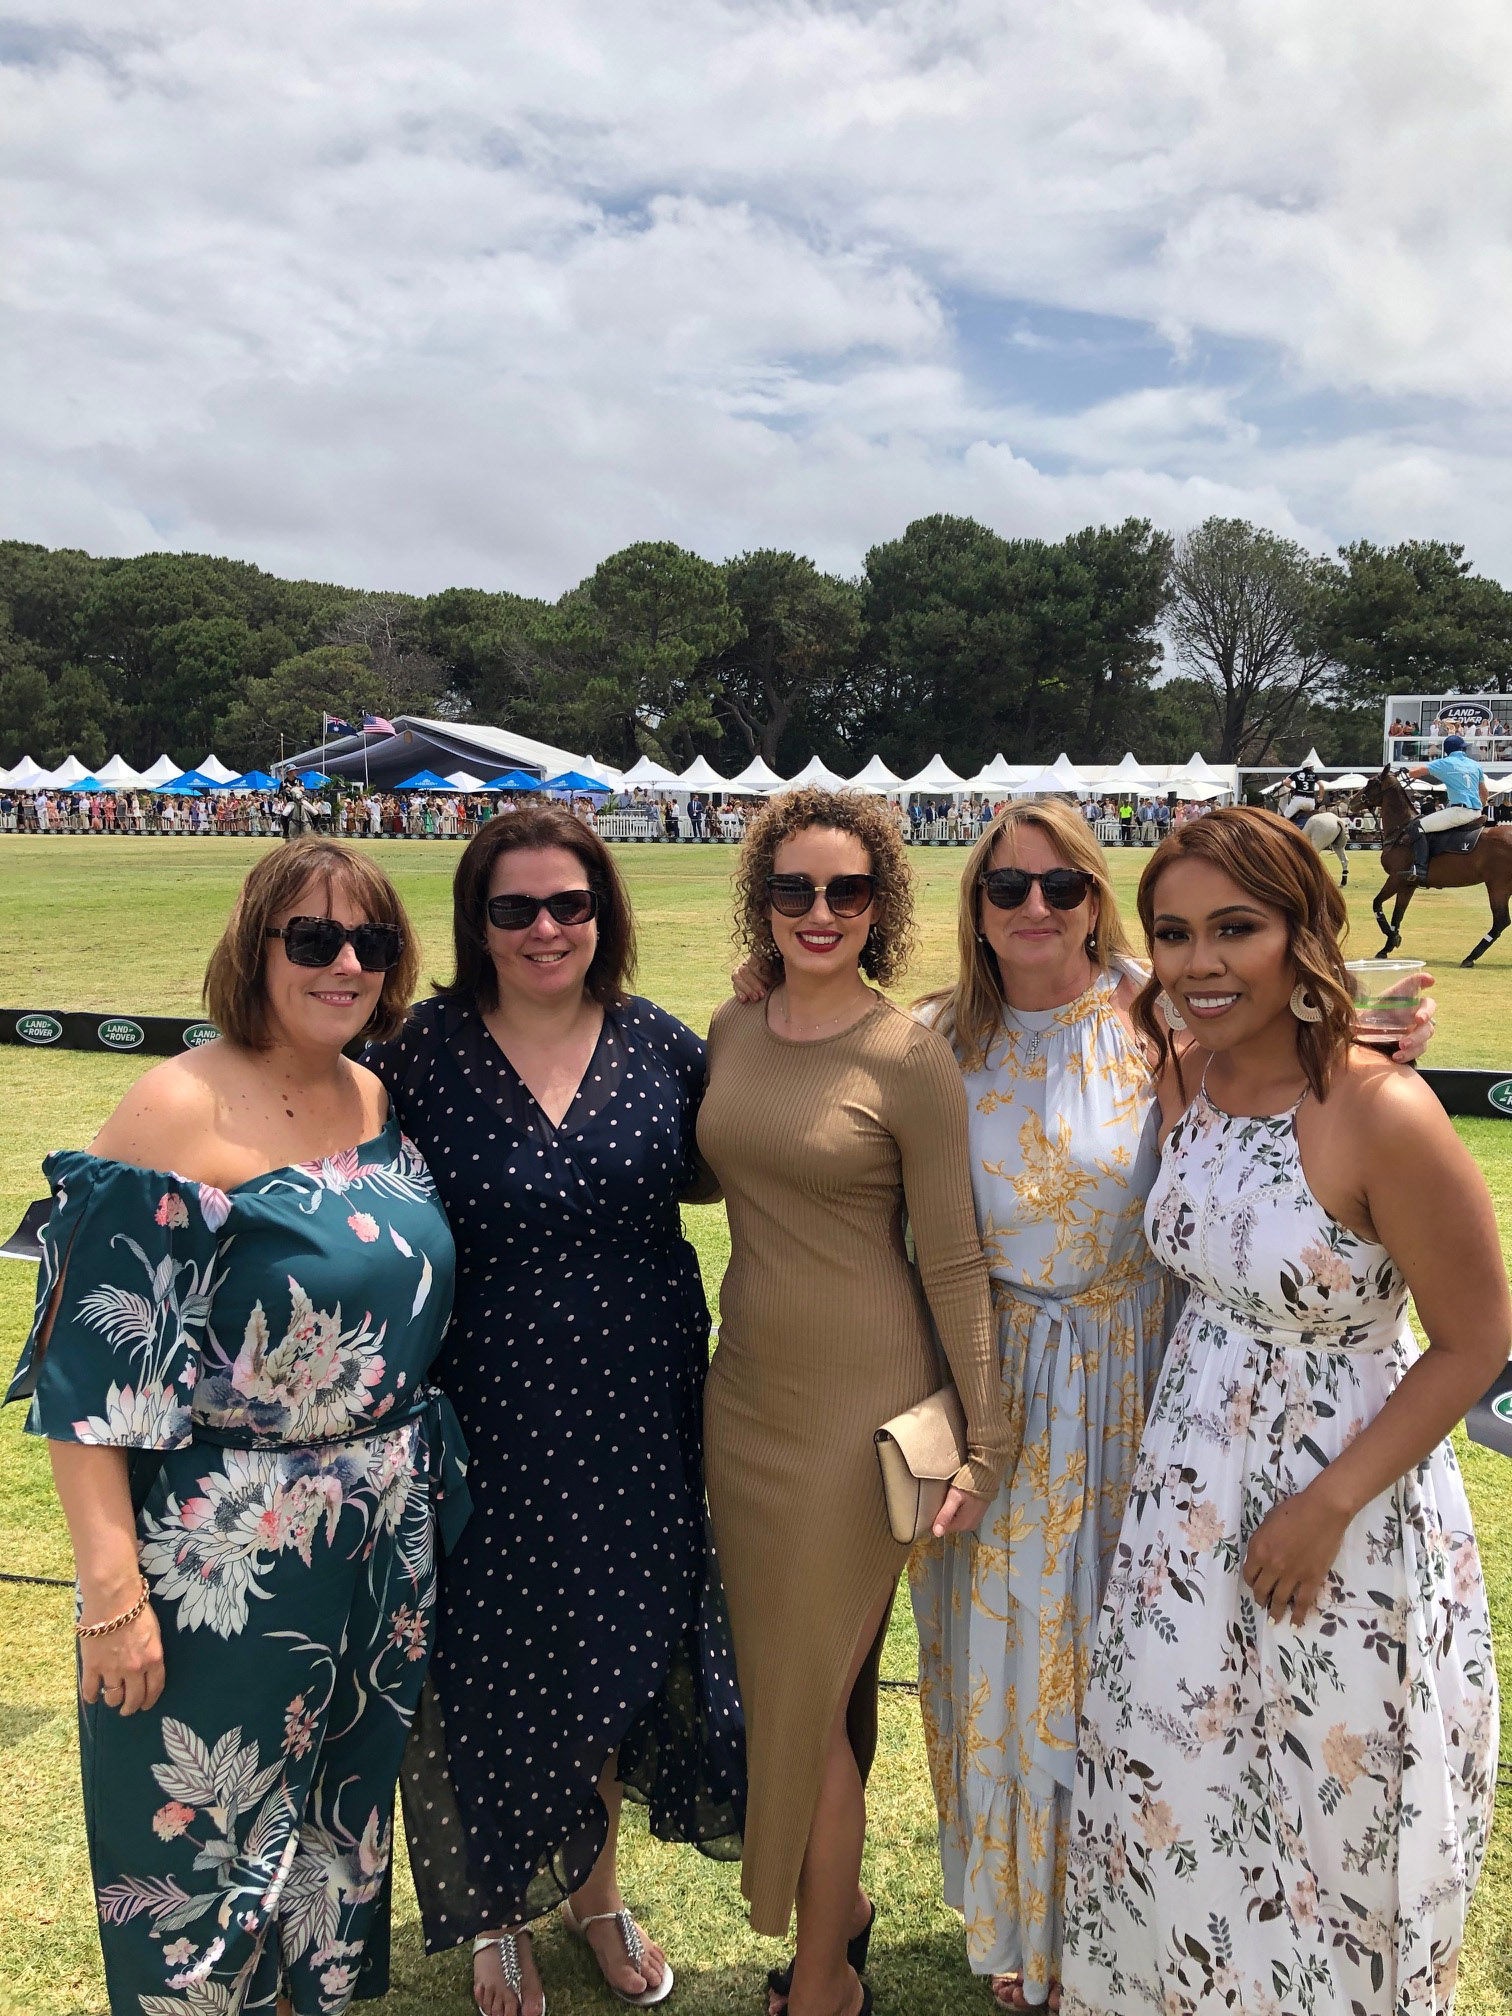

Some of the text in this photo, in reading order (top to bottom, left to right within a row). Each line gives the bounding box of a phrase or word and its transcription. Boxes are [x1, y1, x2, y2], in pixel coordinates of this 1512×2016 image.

[1302, 781, 1309, 790] 3
[25, 1020, 47, 1029] LAND
[28, 1028, 53, 1037] ROVER
[107, 1025, 129, 1034] LAND
[193, 1029, 216, 1038] LAND
[109, 1033, 136, 1042] ROVER
